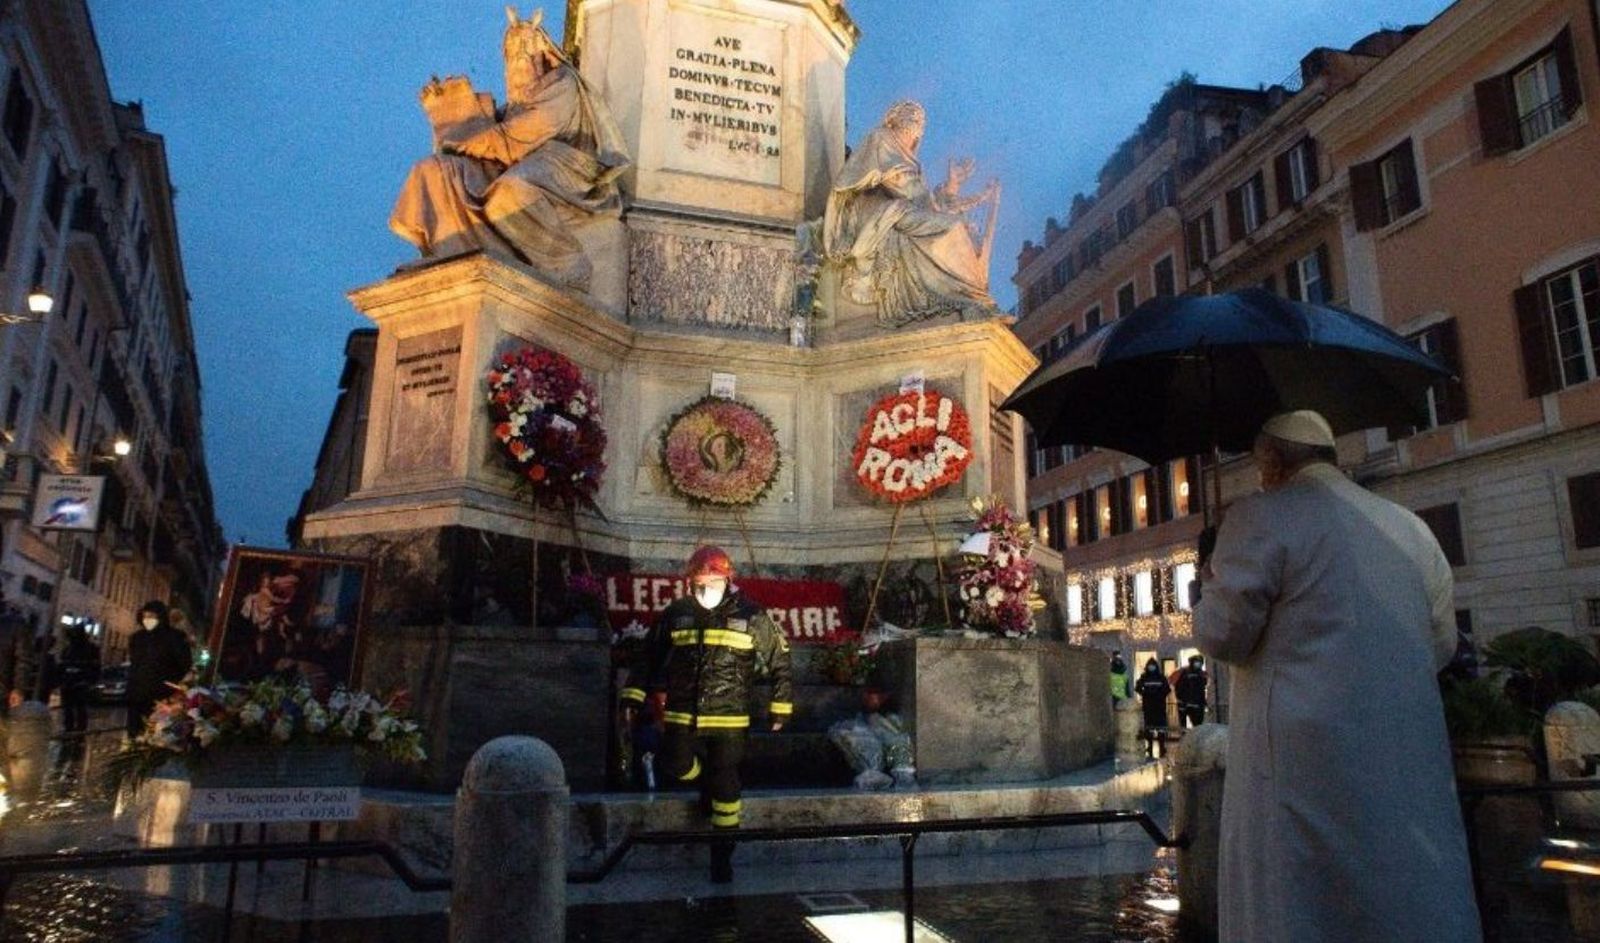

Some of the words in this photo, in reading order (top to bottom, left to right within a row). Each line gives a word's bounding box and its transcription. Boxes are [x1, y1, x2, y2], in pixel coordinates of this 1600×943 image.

[714, 36, 741, 51] AVE
[869, 397, 953, 445] ACLI
[858, 435, 969, 492] ROMA
[606, 577, 692, 612] LEGI
